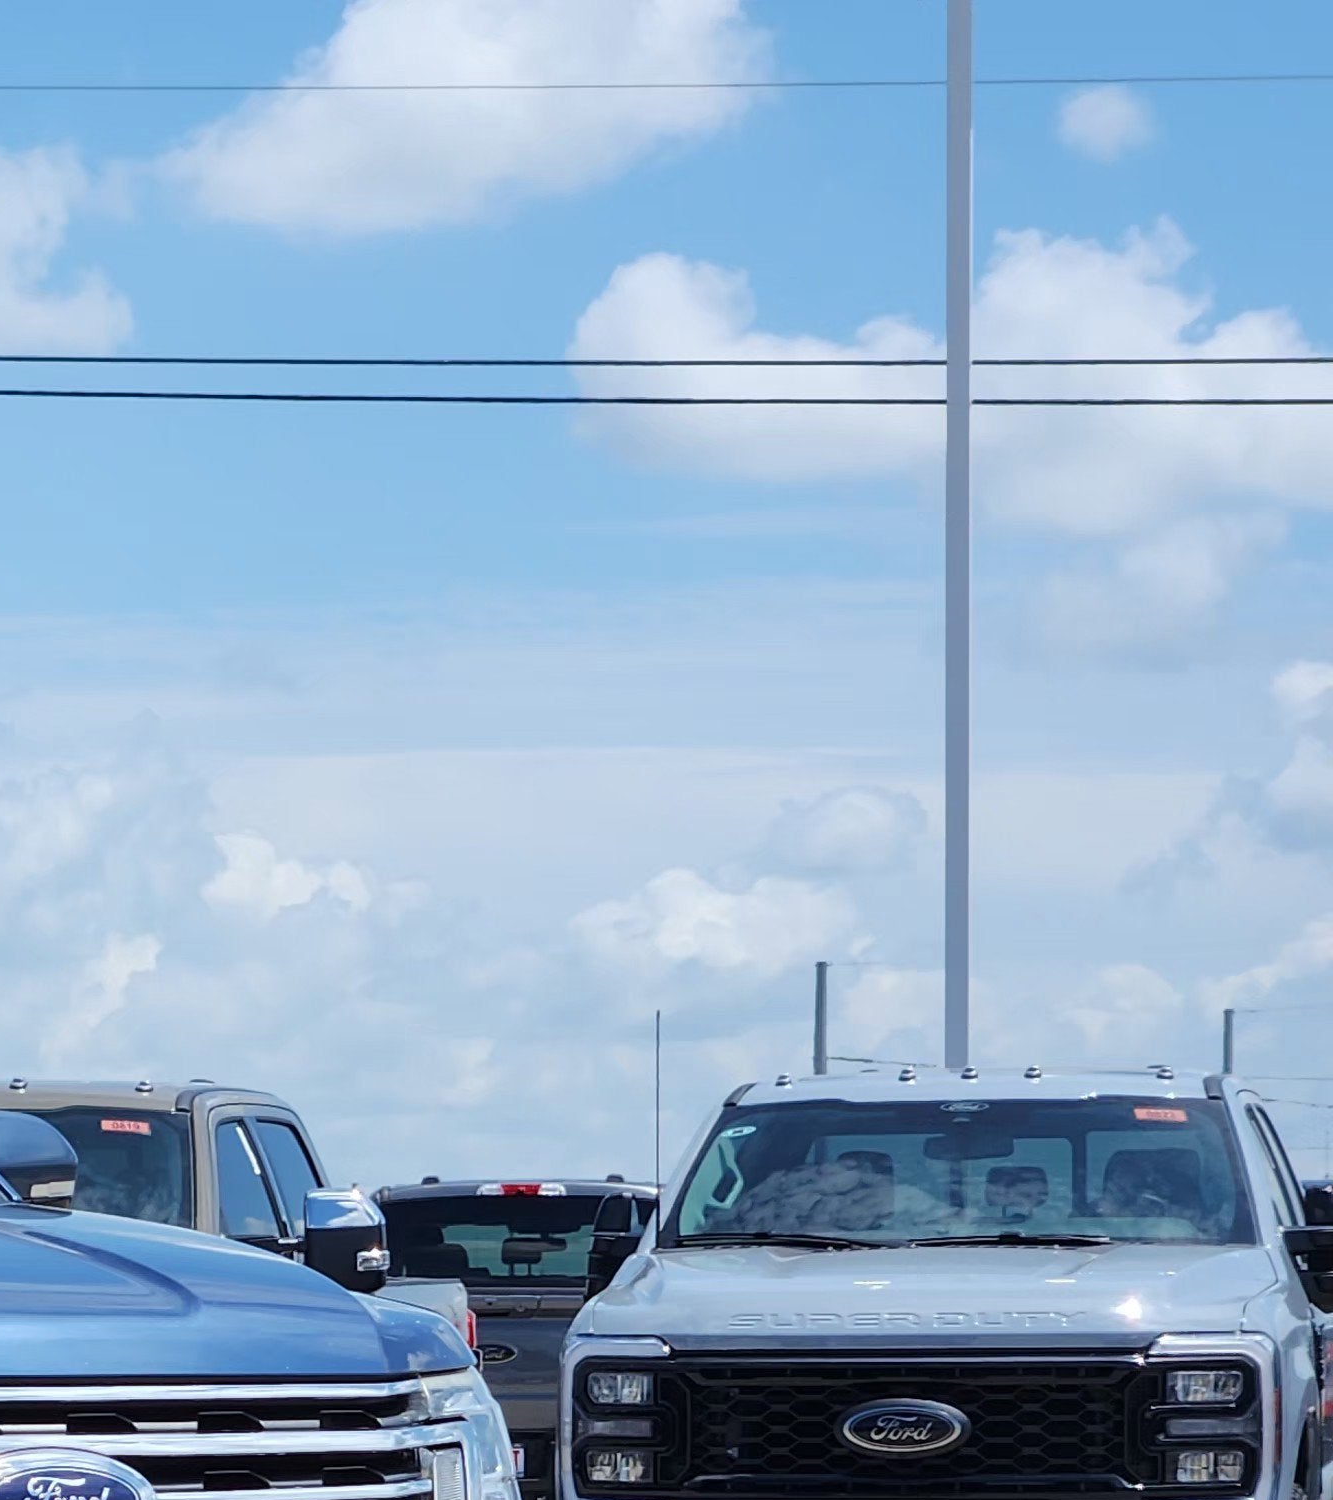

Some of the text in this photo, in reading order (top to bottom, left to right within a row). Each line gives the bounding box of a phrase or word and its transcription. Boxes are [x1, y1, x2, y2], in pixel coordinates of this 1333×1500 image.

[728, 1311, 1087, 1330] SUPER DUTY
[869, 1415, 933, 1442] Ford
